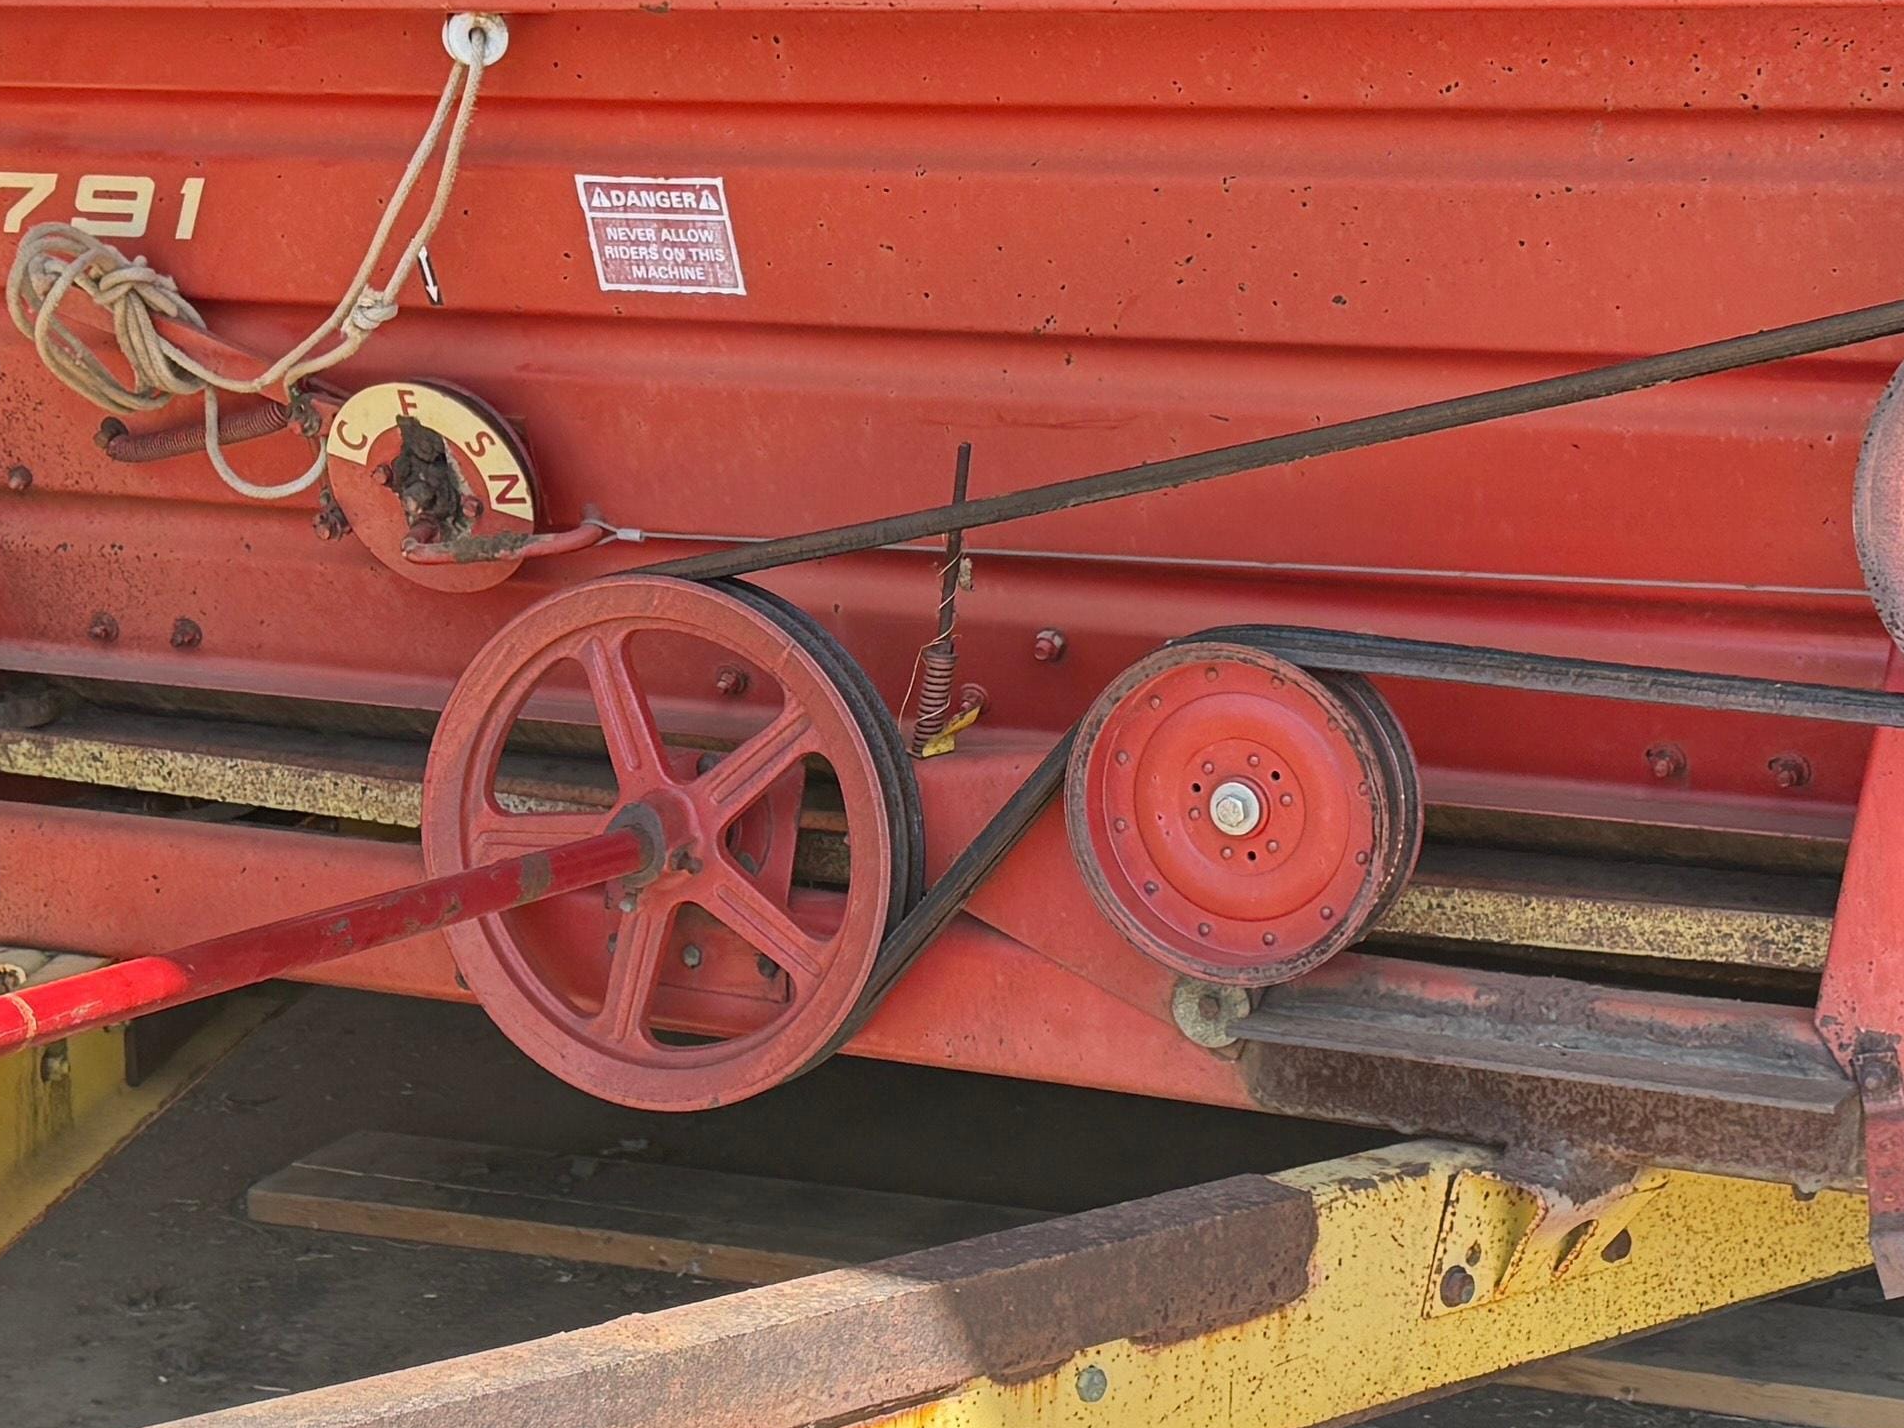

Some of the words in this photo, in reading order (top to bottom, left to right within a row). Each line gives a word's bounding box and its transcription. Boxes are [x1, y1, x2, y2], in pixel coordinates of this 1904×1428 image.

[609, 189, 696, 209] DANGER
[606, 227, 656, 242] NEVER
[661, 228, 714, 243] ALLOW
[604, 245, 659, 260] RIDERS
[662, 247, 686, 262] ON
[689, 248, 725, 262] THIS
[632, 265, 706, 280] MACHINE
[336, 419, 368, 451] C
[397, 389, 418, 416] F
[464, 430, 496, 458] S
[488, 474, 527, 505] N
